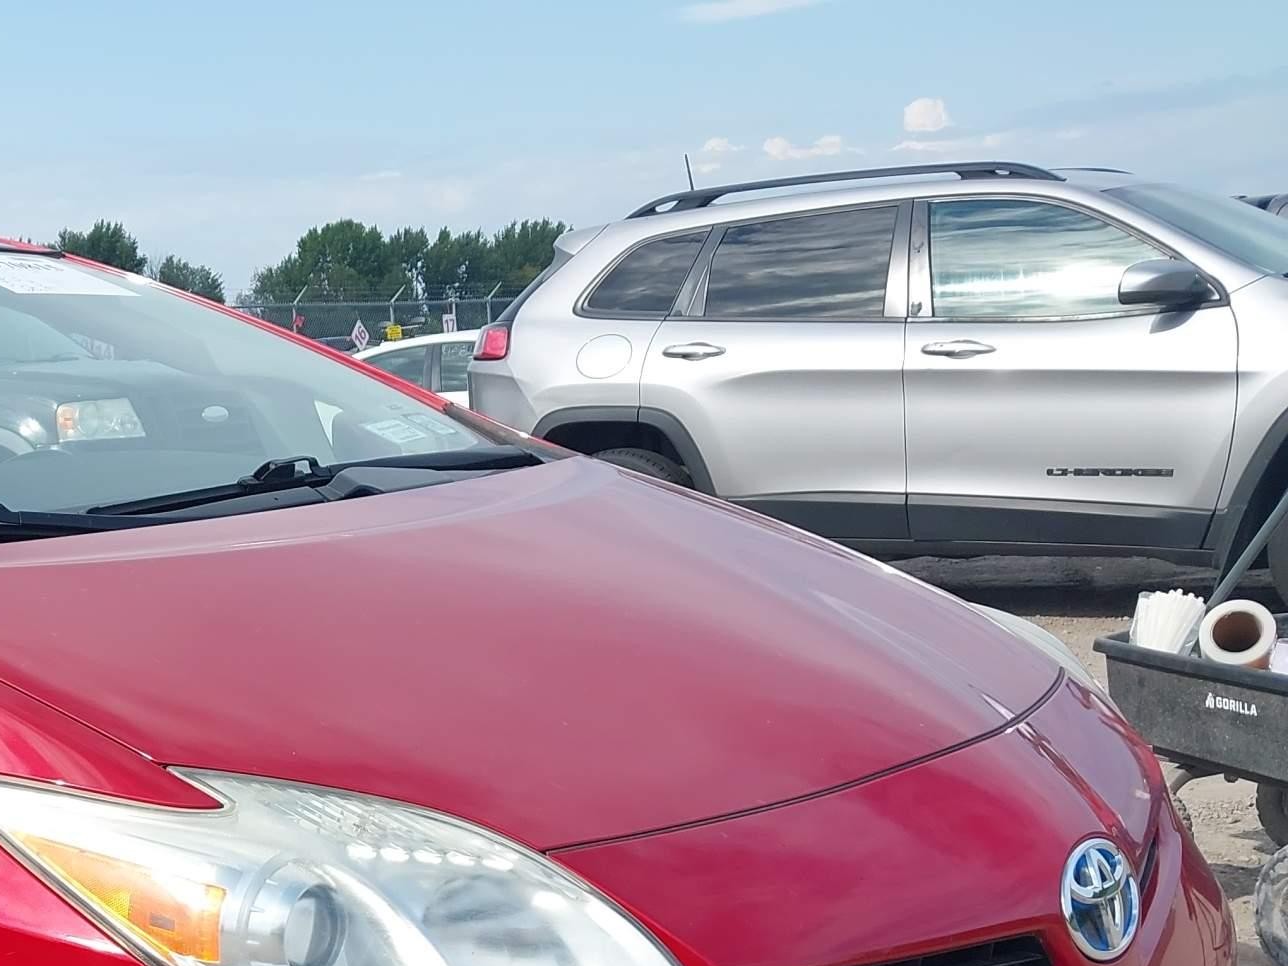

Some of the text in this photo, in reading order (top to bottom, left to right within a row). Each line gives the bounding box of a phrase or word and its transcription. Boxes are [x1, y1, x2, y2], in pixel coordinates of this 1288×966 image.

[355, 326, 366, 346] 16
[1046, 468, 1174, 477] CHEROKEE
[1215, 696, 1258, 717] GORILLA
